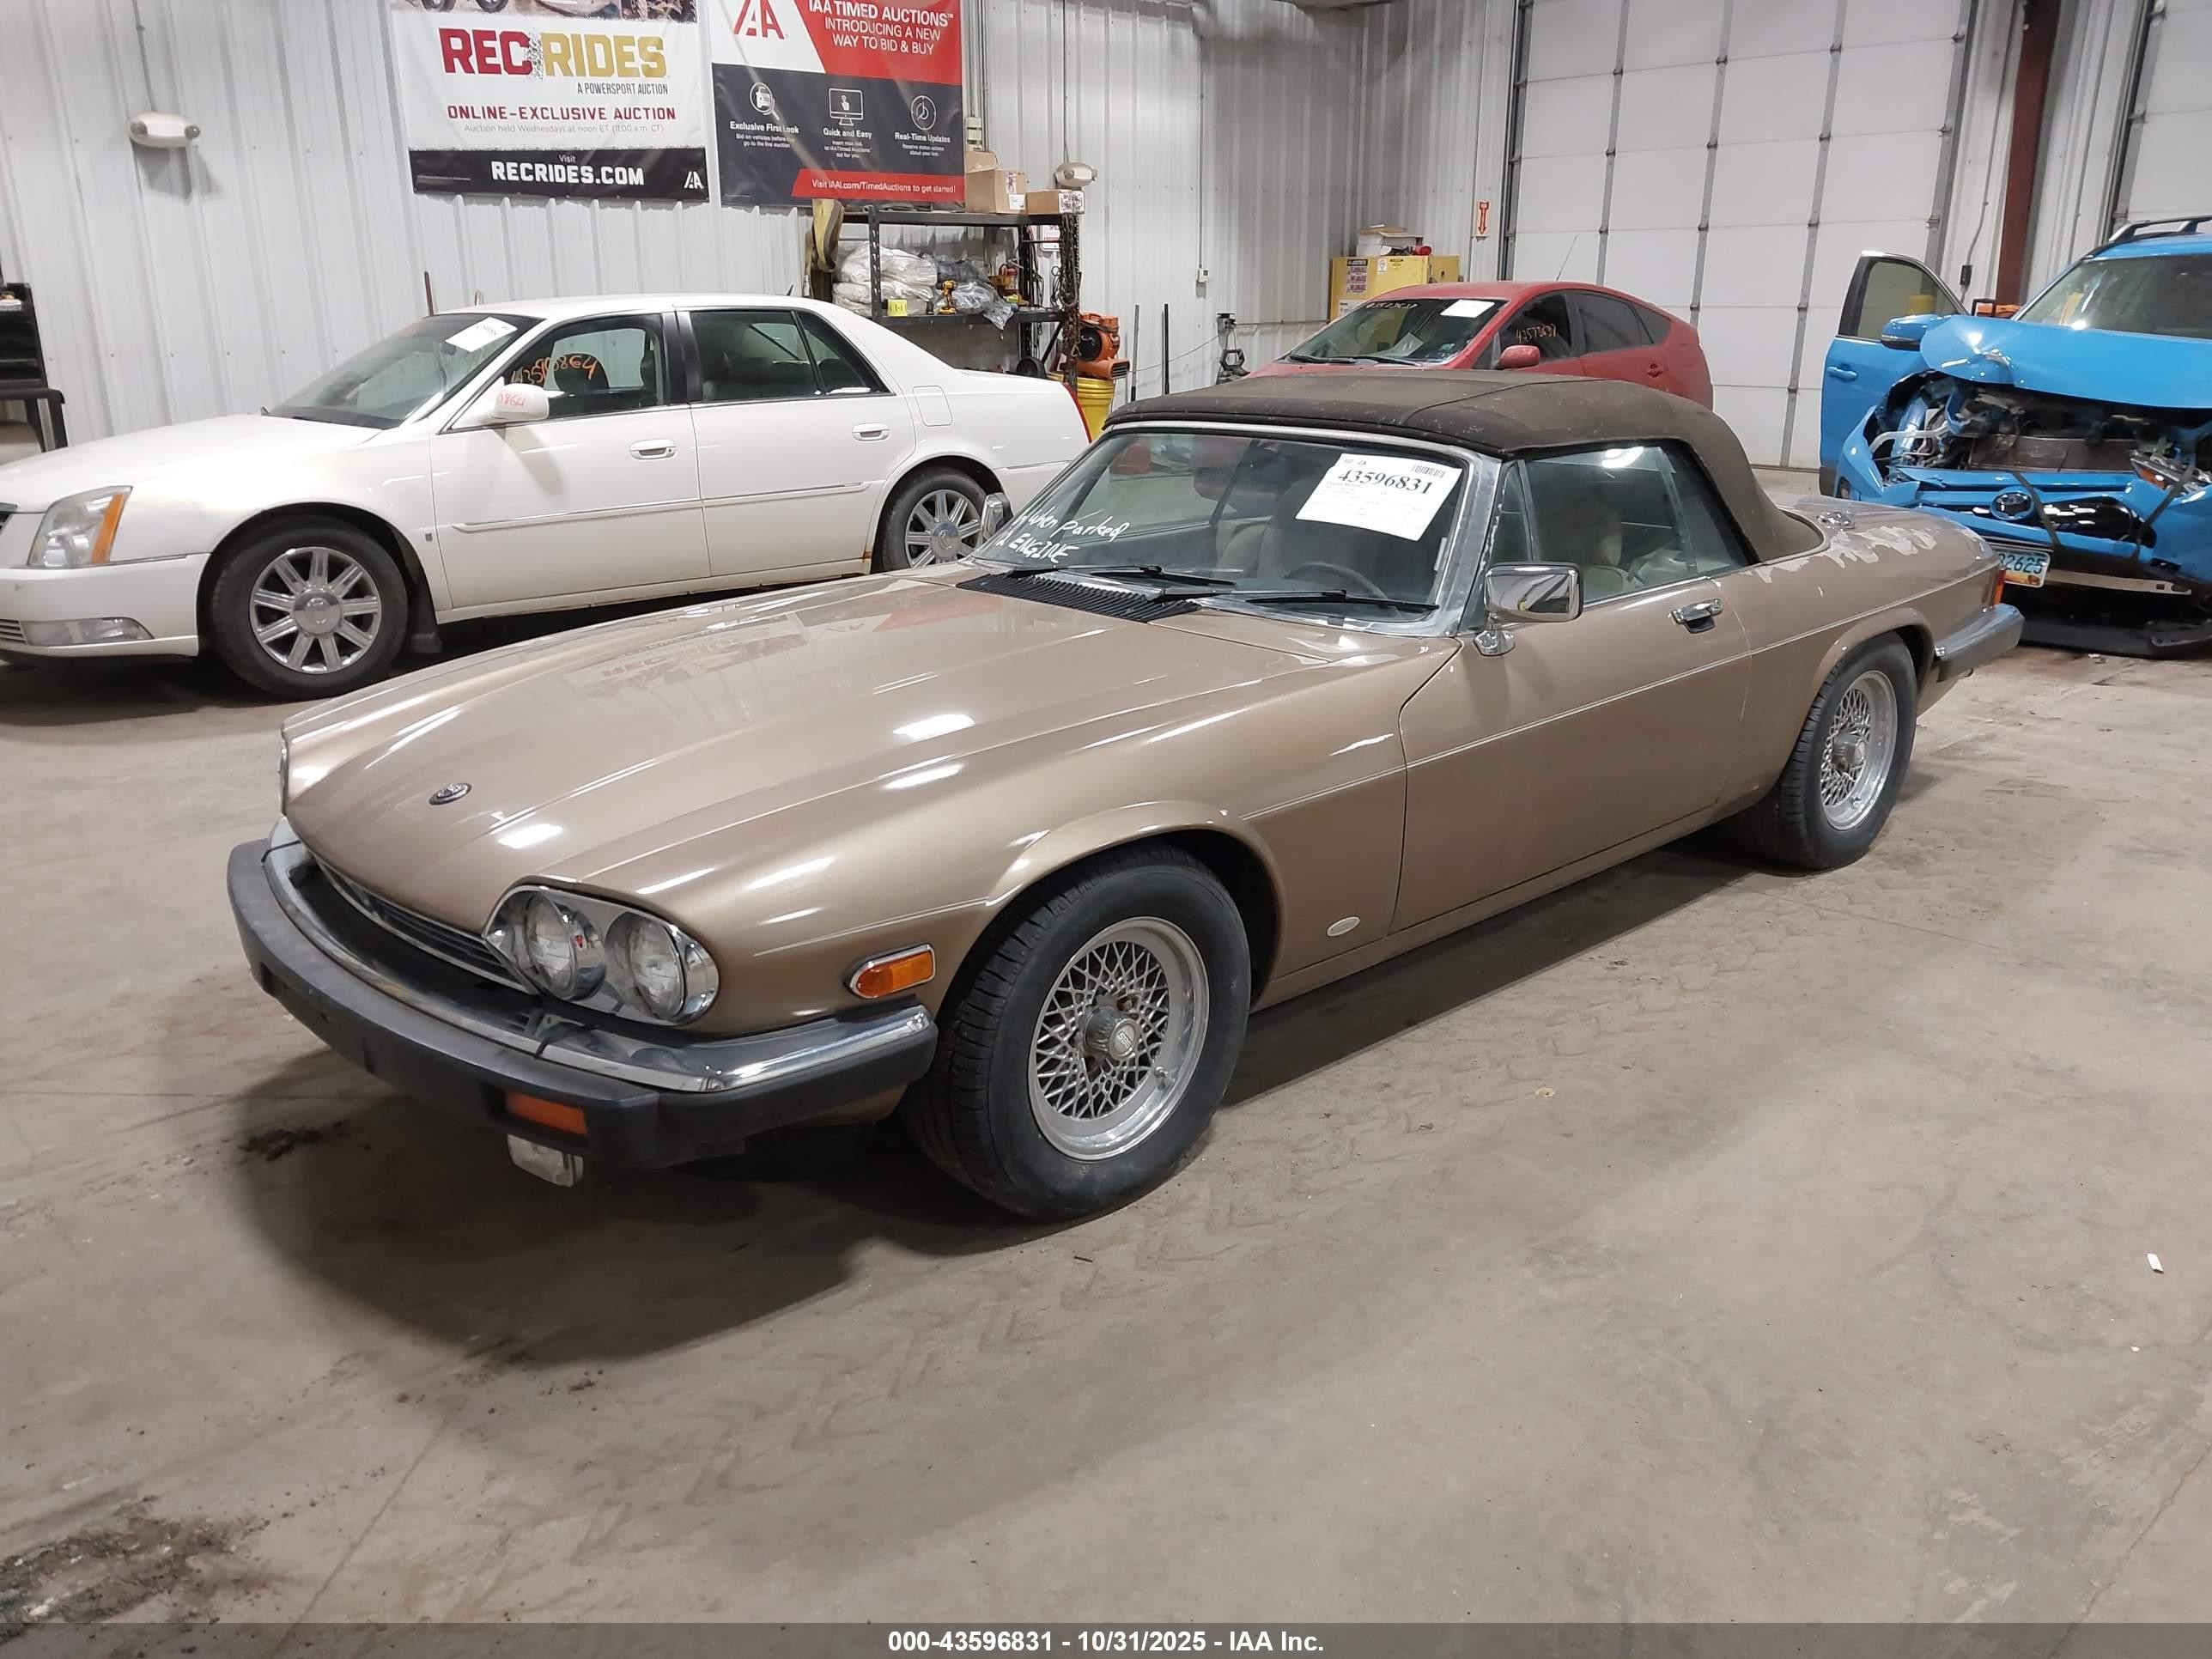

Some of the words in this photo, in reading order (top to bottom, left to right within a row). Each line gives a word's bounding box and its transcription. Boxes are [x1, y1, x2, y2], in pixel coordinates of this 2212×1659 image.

[833, 0, 878, 19] TIMED
[824, 16, 902, 38] INTRODUCING
[904, 27, 913, 38] A
[915, 28, 940, 41] NEW
[439, 27, 533, 76] REC
[541, 32, 667, 78] RIDES
[832, 33, 859, 47] WAY
[862, 35, 878, 50] TO
[880, 38, 897, 52] BID
[900, 40, 909, 53] &
[912, 42, 934, 55] BUY
[577, 82, 583, 94] A
[585, 82, 636, 94] POWERSPORT
[638, 83, 668, 94] AUCTION
[447, 105, 607, 120] ONLINE-EXCLUSIVE
[613, 106, 677, 120] AUCTION
[465, 124, 495, 132] Auction
[517, 125, 566, 134] Wednesdays
[730, 120, 765, 131] Exclusive
[766, 123, 782, 132] First
[823, 127, 841, 137] Quick
[856, 130, 872, 140] Easy
[895, 131, 927, 142] Real-Time
[928, 134, 951, 143] Updates
[558, 154, 576, 163] Visit
[490, 161, 644, 185] RECRIDES.COM
[812, 179, 827, 188] Visit
[921, 185, 933, 194] get
[1338, 469, 1434, 495] 43596831
[1049, 510, 1130, 543] Parked
[1008, 532, 1080, 563] ENGINE
